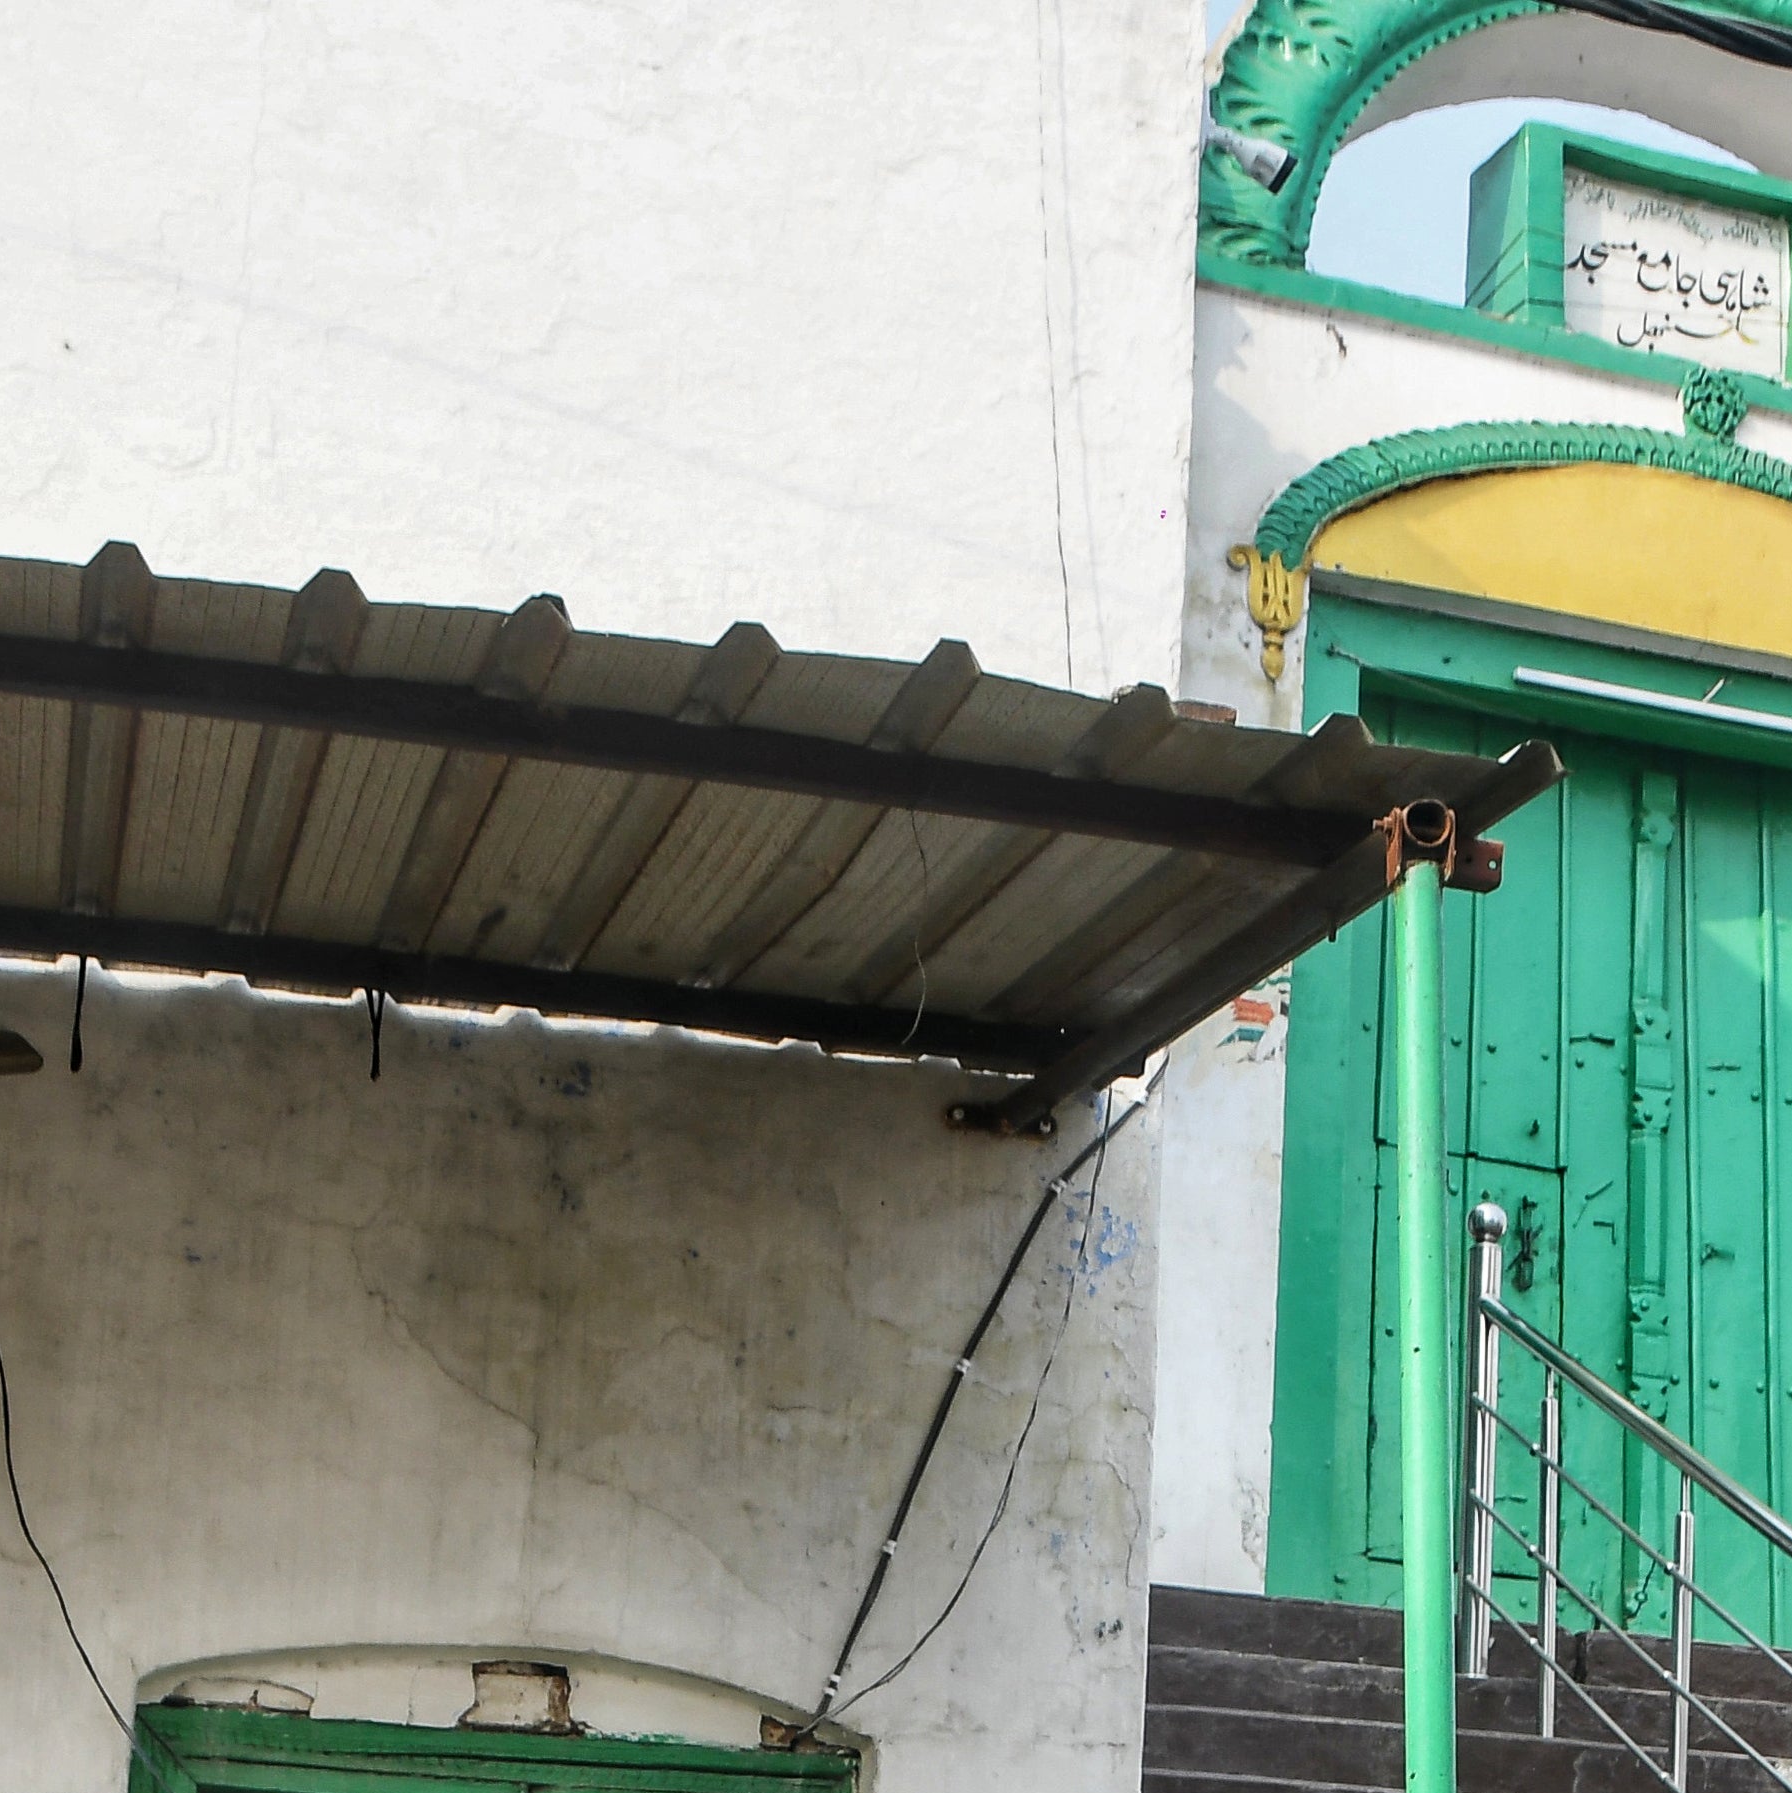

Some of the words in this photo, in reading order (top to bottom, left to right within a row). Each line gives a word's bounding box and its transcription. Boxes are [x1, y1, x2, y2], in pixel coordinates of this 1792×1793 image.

[1567, 239, 1638, 285] مسجد
[1637, 249, 1697, 309] جامع
[1699, 267, 1772, 311] شاہی
